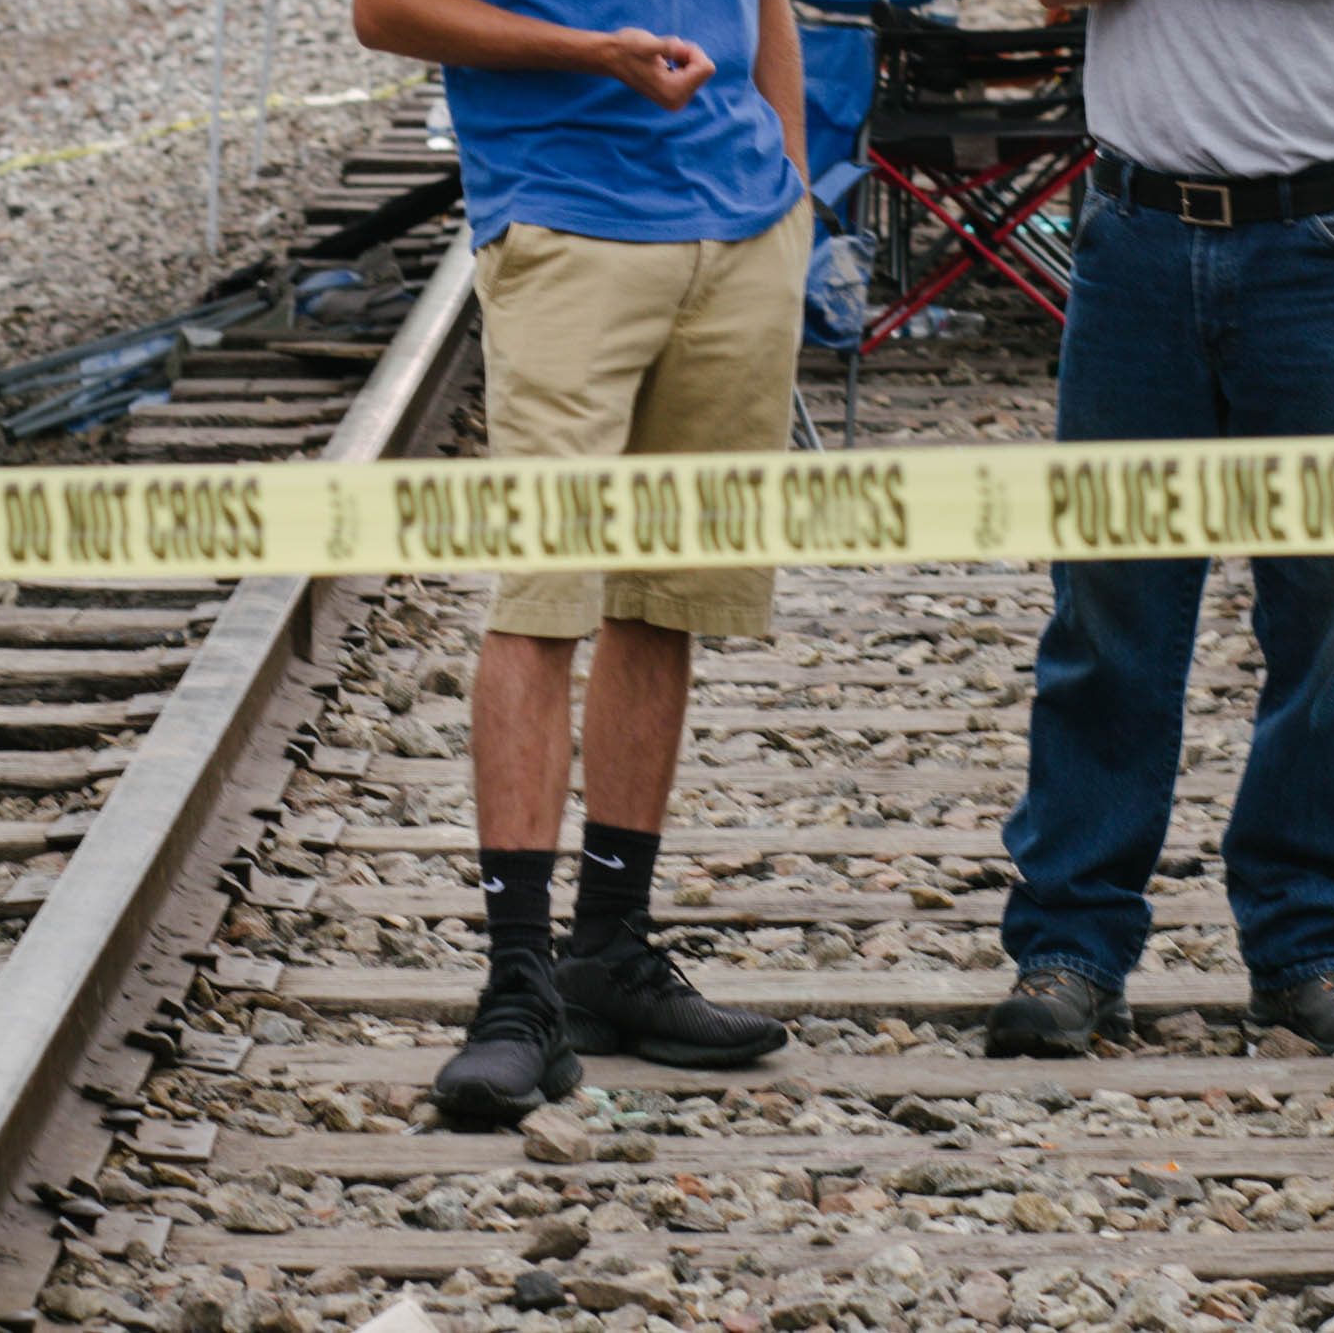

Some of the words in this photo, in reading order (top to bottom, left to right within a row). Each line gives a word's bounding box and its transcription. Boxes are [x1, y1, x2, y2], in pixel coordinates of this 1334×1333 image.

[3, 482, 52, 563] DO
[63, 480, 129, 562] NOT
[144, 478, 264, 561] CROSS
[394, 474, 524, 559] POLICE
[536, 472, 619, 556] LINE
[631, 470, 682, 554] DO
[695, 468, 765, 552] NOT
[781, 463, 908, 551] CROSS
[1048, 458, 1186, 548] POLICE
[1198, 455, 1287, 544] LINE
